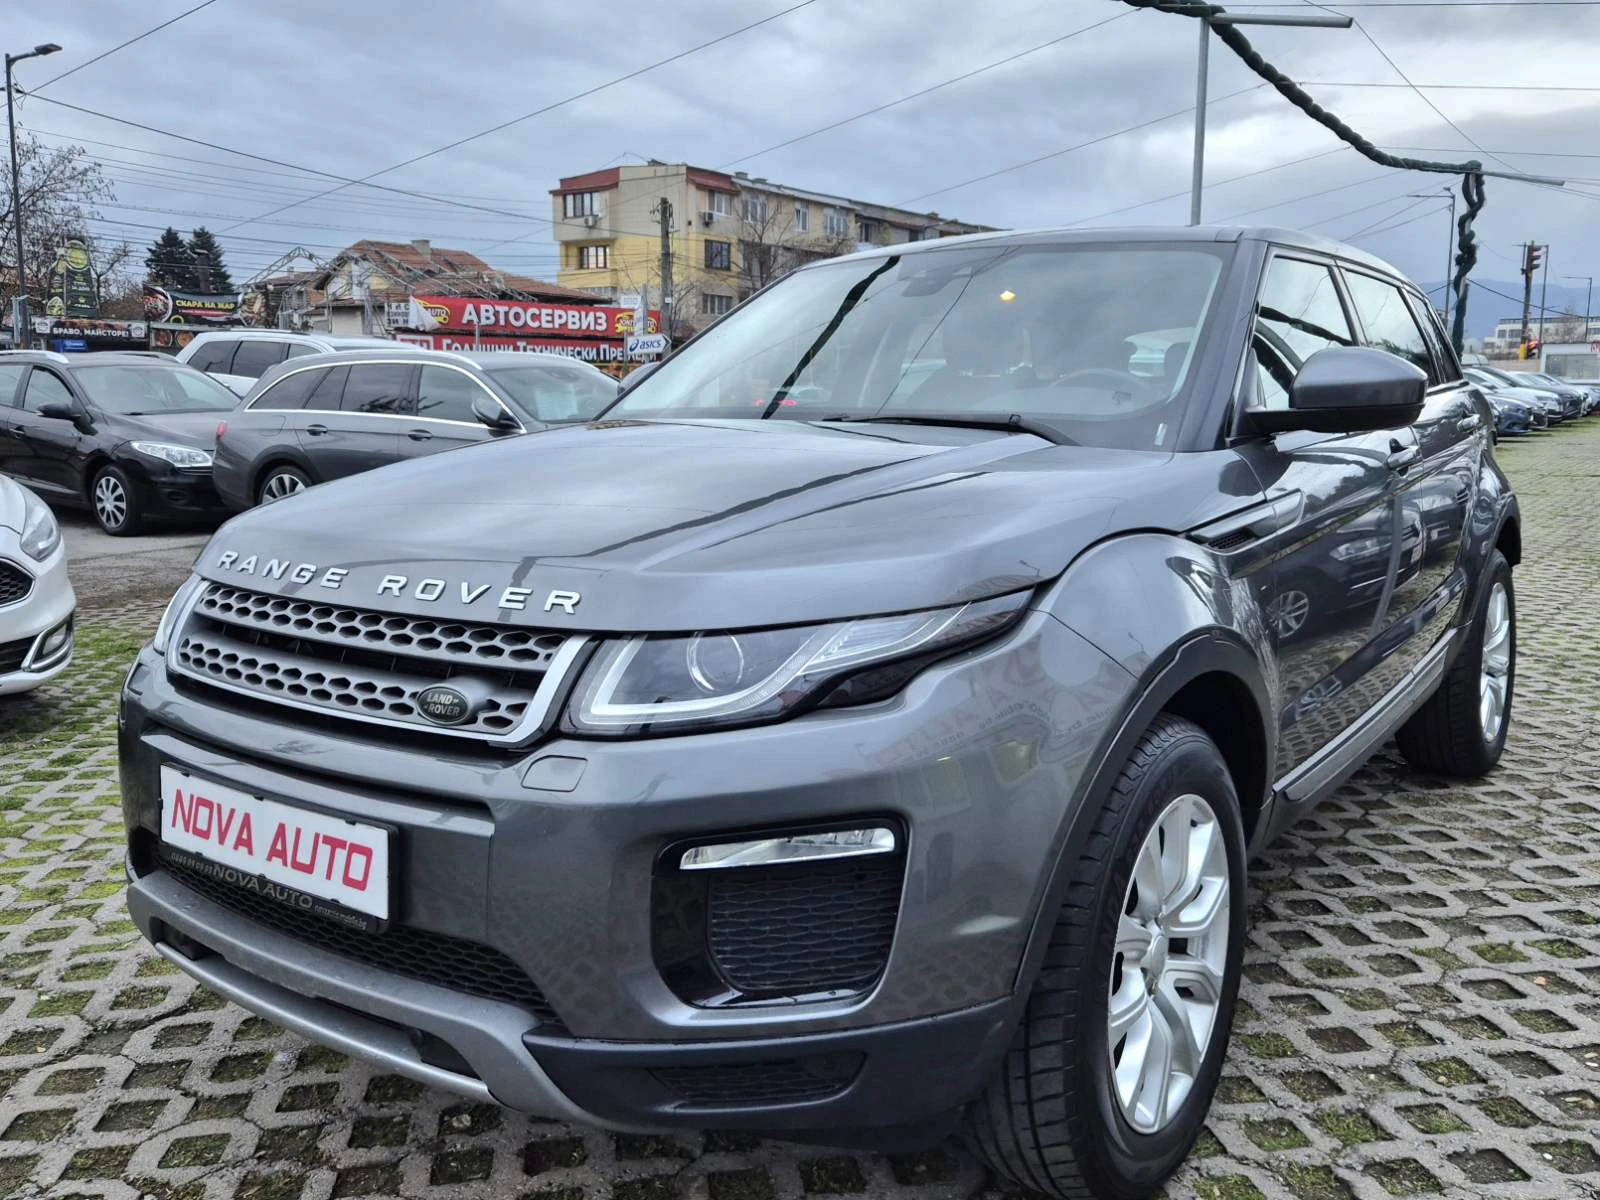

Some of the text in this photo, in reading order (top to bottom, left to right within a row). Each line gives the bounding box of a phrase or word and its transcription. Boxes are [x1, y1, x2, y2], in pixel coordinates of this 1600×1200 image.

[204, 301, 216, 309] НА
[462, 303, 607, 331] АВТОСЕРВИЗ
[216, 550, 582, 615] RANGE ROVER
[427, 692, 453, 705] LAND
[428, 703, 461, 717] ROVER
[171, 788, 374, 892] NOVA AUTO
[213, 863, 260, 891] NOVA
[263, 883, 313, 909] AUTO
